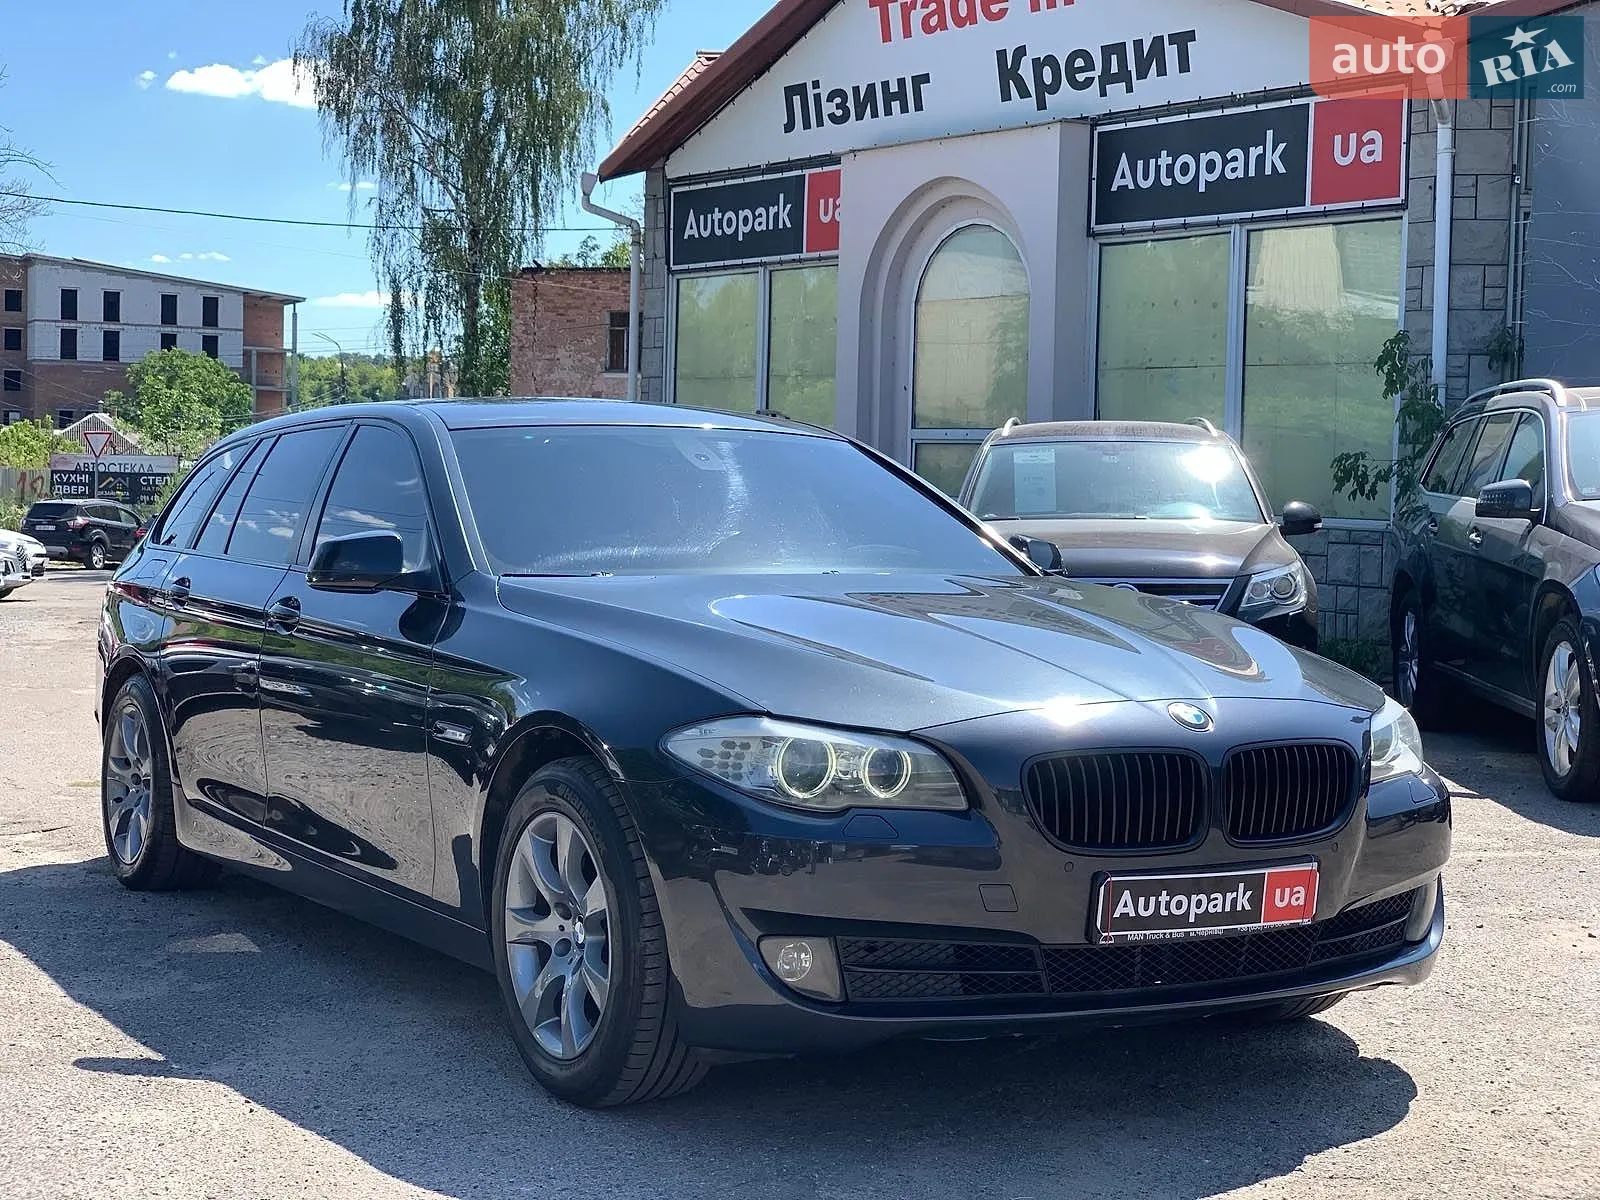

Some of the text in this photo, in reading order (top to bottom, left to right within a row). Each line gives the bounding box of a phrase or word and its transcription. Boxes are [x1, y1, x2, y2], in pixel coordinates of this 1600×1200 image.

[783, 29, 1197, 134] Лізинг Кредит
[1110, 128, 1384, 193] Autopark ua
[683, 193, 793, 241] Autopark
[52, 473, 90, 484] КУХНІ
[53, 485, 90, 496] ДВЕРІ
[1112, 882, 1306, 923] Autopark ua
[1127, 932, 1144, 941] MAN
[1145, 932, 1164, 940] Truck
